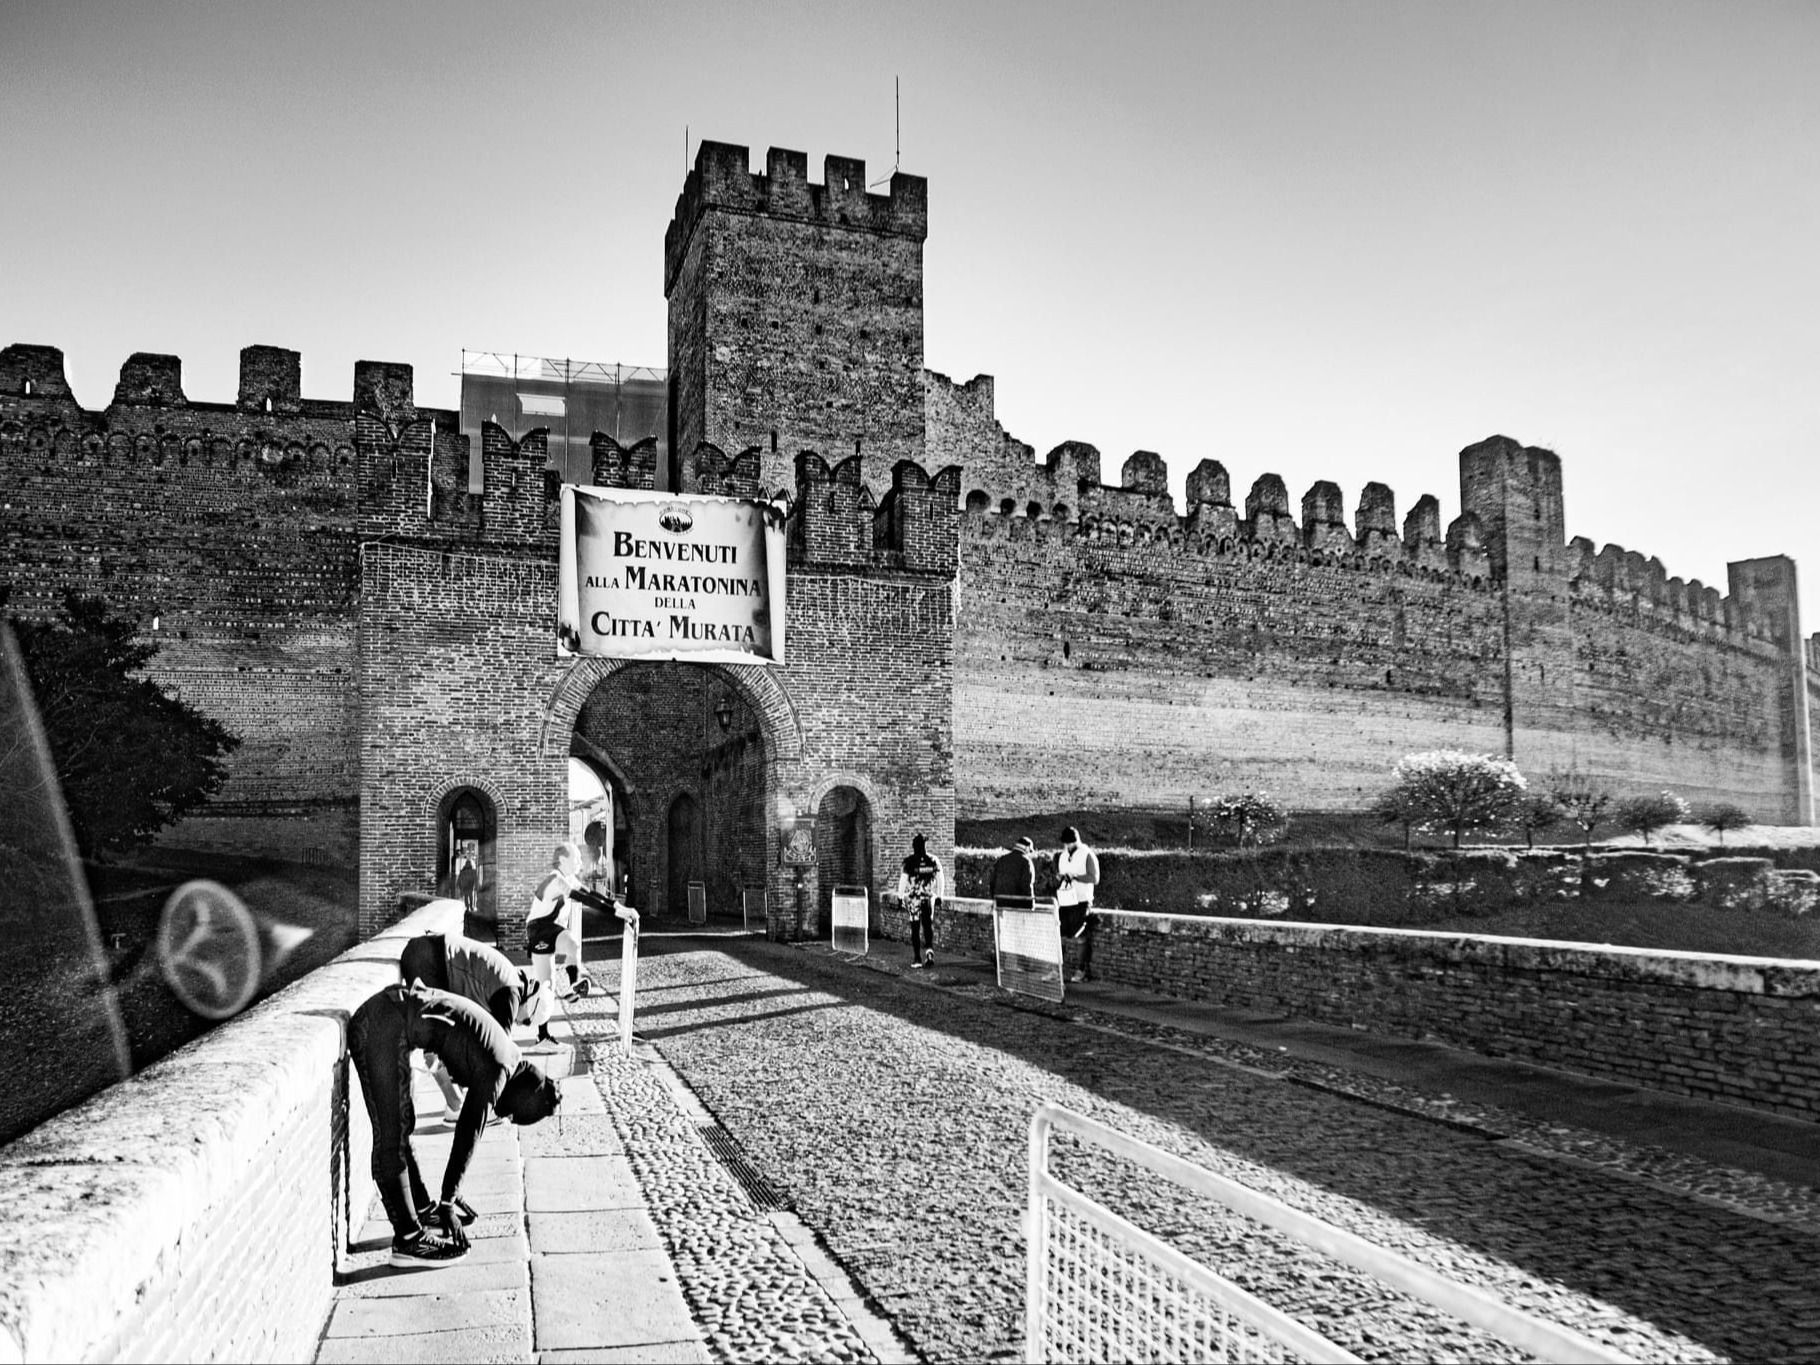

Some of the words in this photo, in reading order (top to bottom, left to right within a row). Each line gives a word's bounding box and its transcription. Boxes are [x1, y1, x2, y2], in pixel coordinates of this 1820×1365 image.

[613, 531, 737, 563] BENVENUTI
[585, 575, 619, 589] ALLA
[625, 565, 761, 596] MARATONINA
[654, 596, 696, 609] DELLA
[591, 611, 660, 637] CITTA'
[669, 615, 755, 642] MURATA
